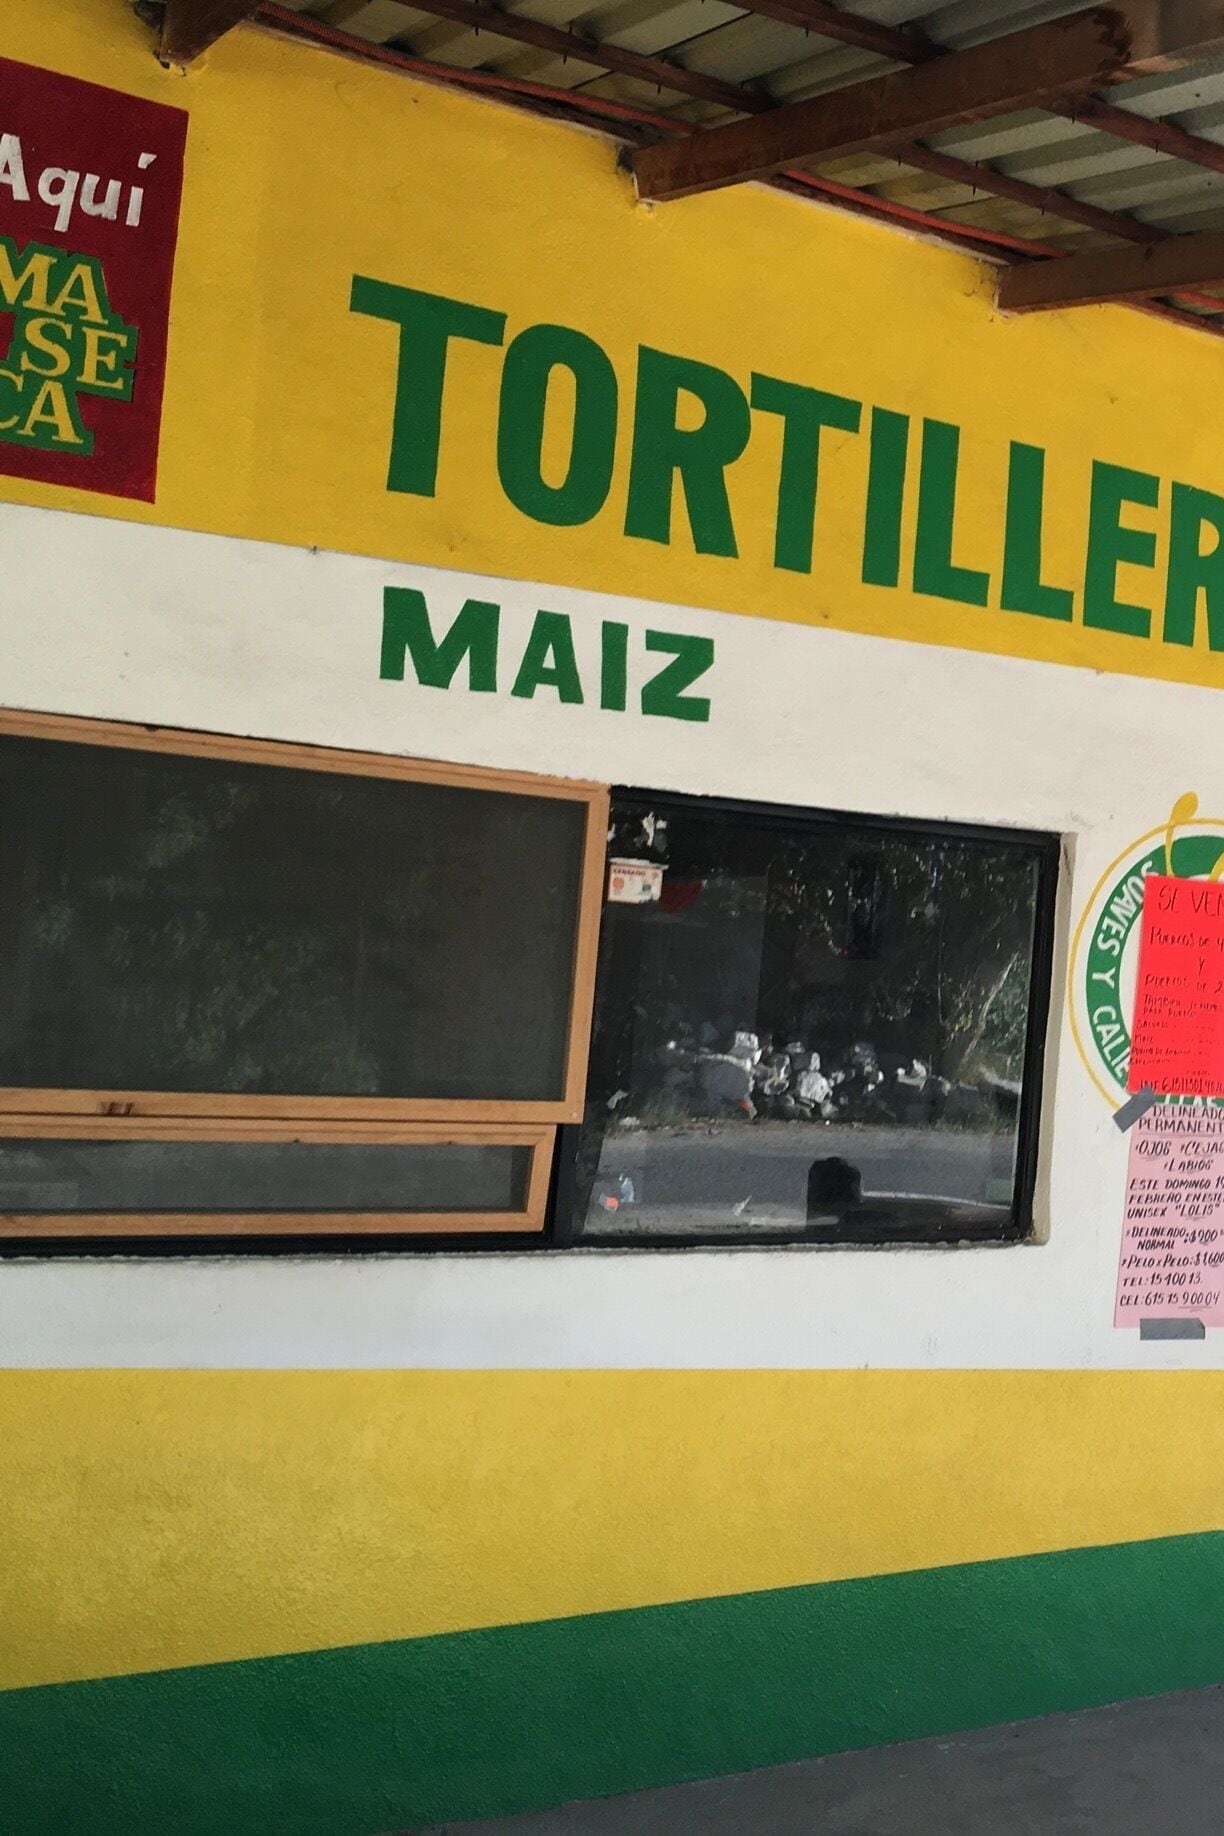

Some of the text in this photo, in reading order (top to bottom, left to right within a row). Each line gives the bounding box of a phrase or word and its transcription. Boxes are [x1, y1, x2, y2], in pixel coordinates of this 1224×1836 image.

[0, 133, 157, 232] Aquí
[21, 317, 128, 390] SE
[379, 586, 714, 721] MAIZ
[1092, 967, 1116, 989] Y
[1129, 1178, 1159, 1191] ESTE
[1165, 1178, 1212, 1190] DOMINGO
[1128, 1193, 1182, 1205] FEBRERO
[1127, 1206, 1168, 1219] UNISEX
[1137, 1239, 1176, 1251] NORMAL
